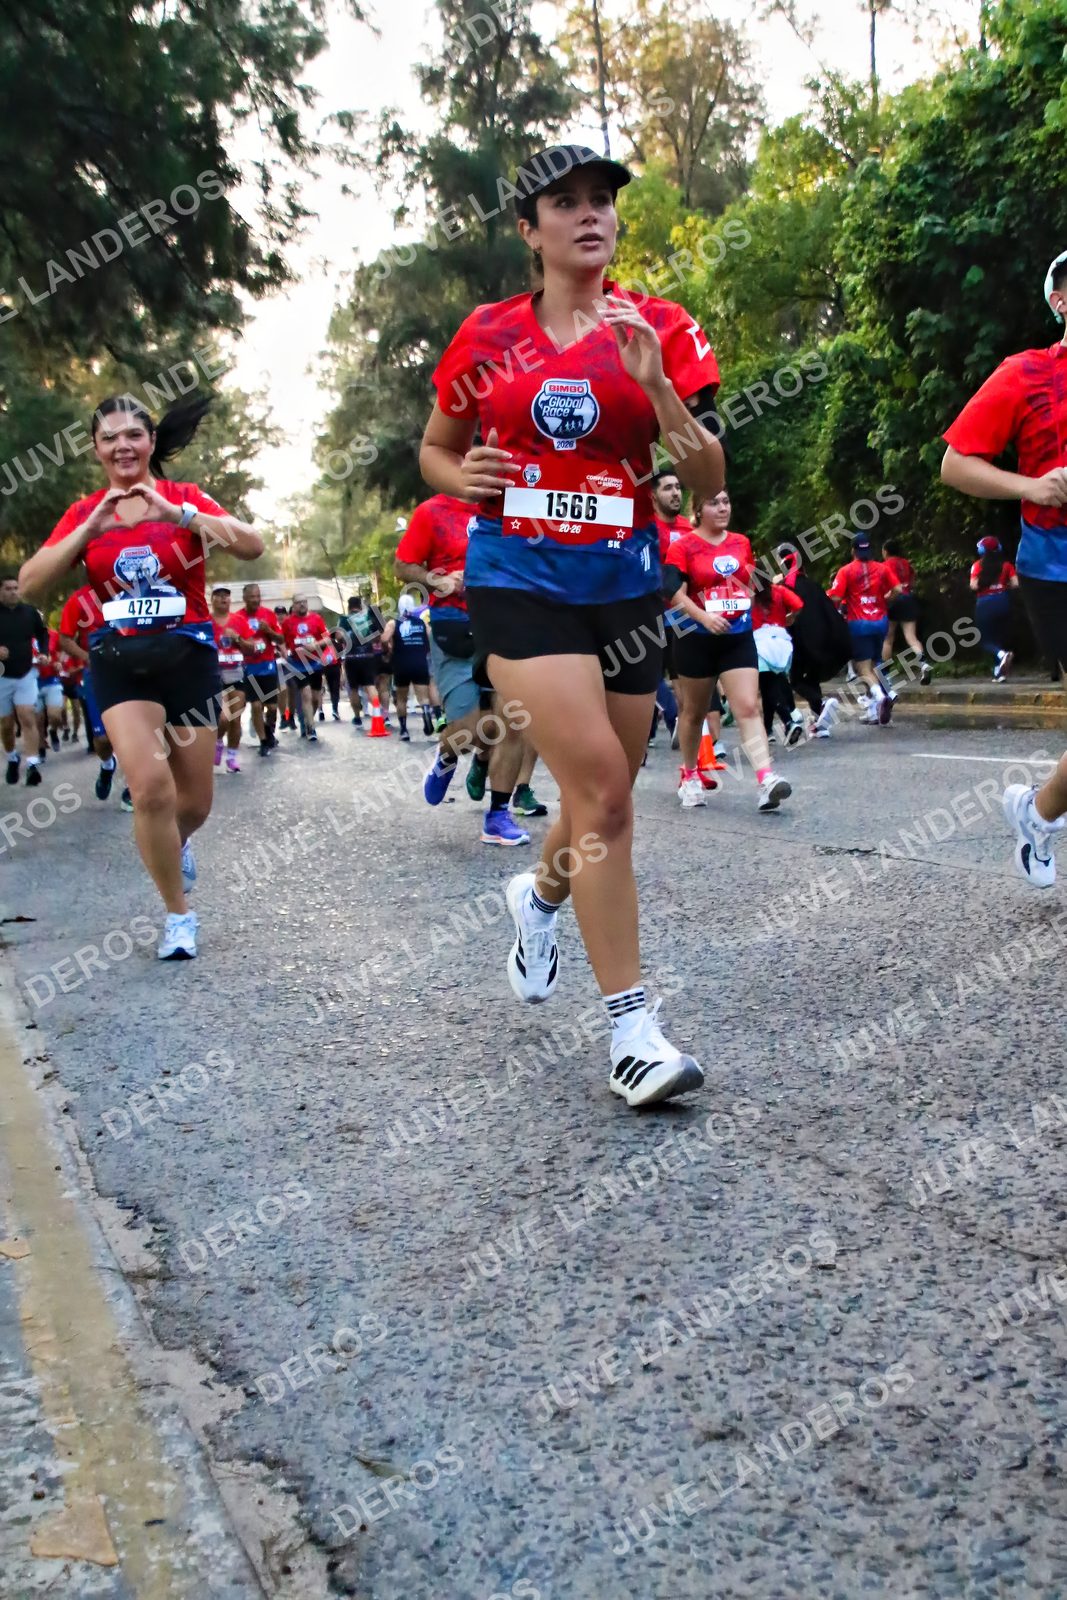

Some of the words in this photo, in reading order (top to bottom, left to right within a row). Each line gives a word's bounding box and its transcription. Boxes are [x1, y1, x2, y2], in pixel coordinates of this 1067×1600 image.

[548, 385, 585, 394] BIMBO
[548, 397, 584, 409] Global
[542, 407, 571, 418] Race
[556, 440, 575, 449] 2026
[546, 492, 598, 521] 1566
[607, 540, 621, 549] 5K
[128, 599, 161, 616] 4727
[722, 600, 738, 610] 1515
